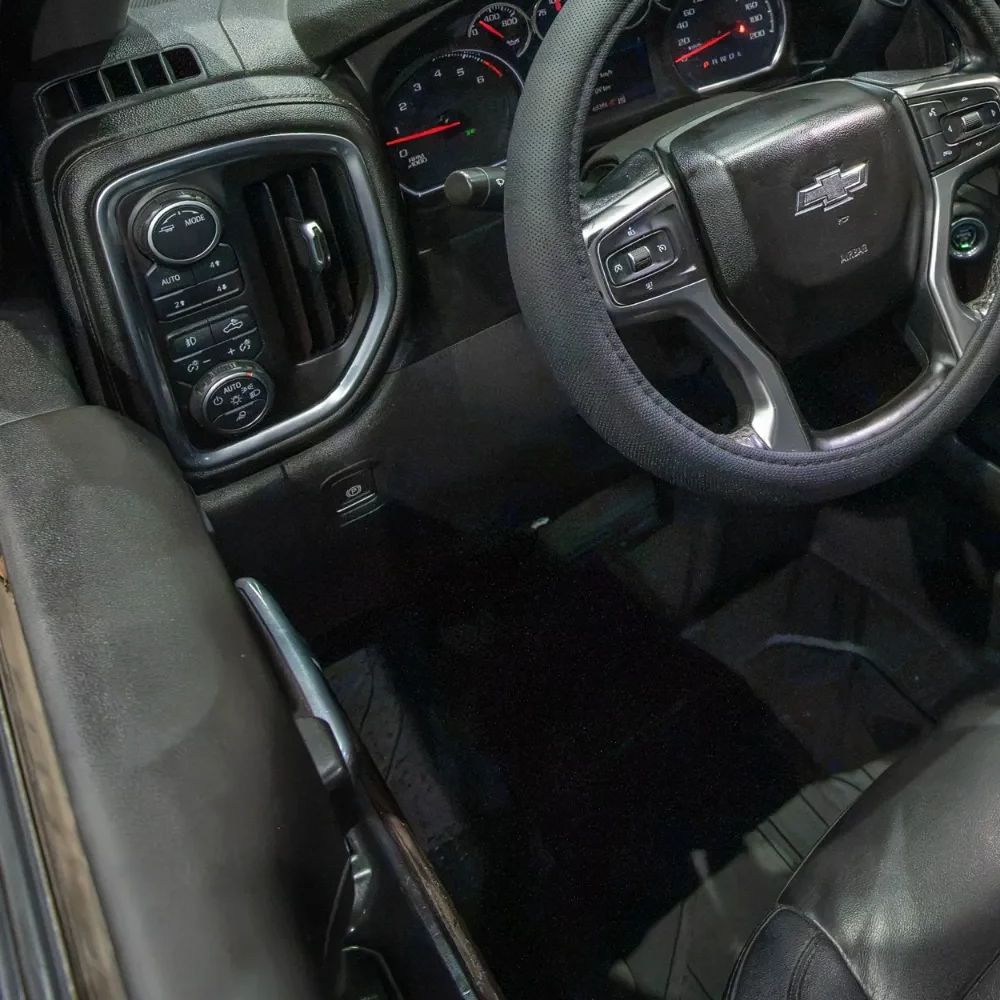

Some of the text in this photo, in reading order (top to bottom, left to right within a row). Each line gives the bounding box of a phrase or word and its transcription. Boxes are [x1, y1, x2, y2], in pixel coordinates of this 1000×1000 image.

[744, 1, 758, 11] 160
[538, 9, 547, 17] 75
[682, 8, 695, 17] 60
[483, 12, 500, 23] 400
[501, 17, 518, 28] 800
[676, 21, 689, 30] 40
[472, 28, 478, 36] 0
[749, 29, 765, 40] 200
[678, 36, 690, 47] 20
[434, 69, 442, 77] 4
[457, 67, 465, 76] 5
[476, 75, 485, 84] 6
[413, 82, 422, 92] 3
[398, 102, 408, 111] 2
[394, 126, 400, 134] 1
[399, 149, 408, 158] 0
[184, 213, 206, 227] MODE
[161, 274, 181, 286] AUTO
[223, 381, 242, 395] AUTO
